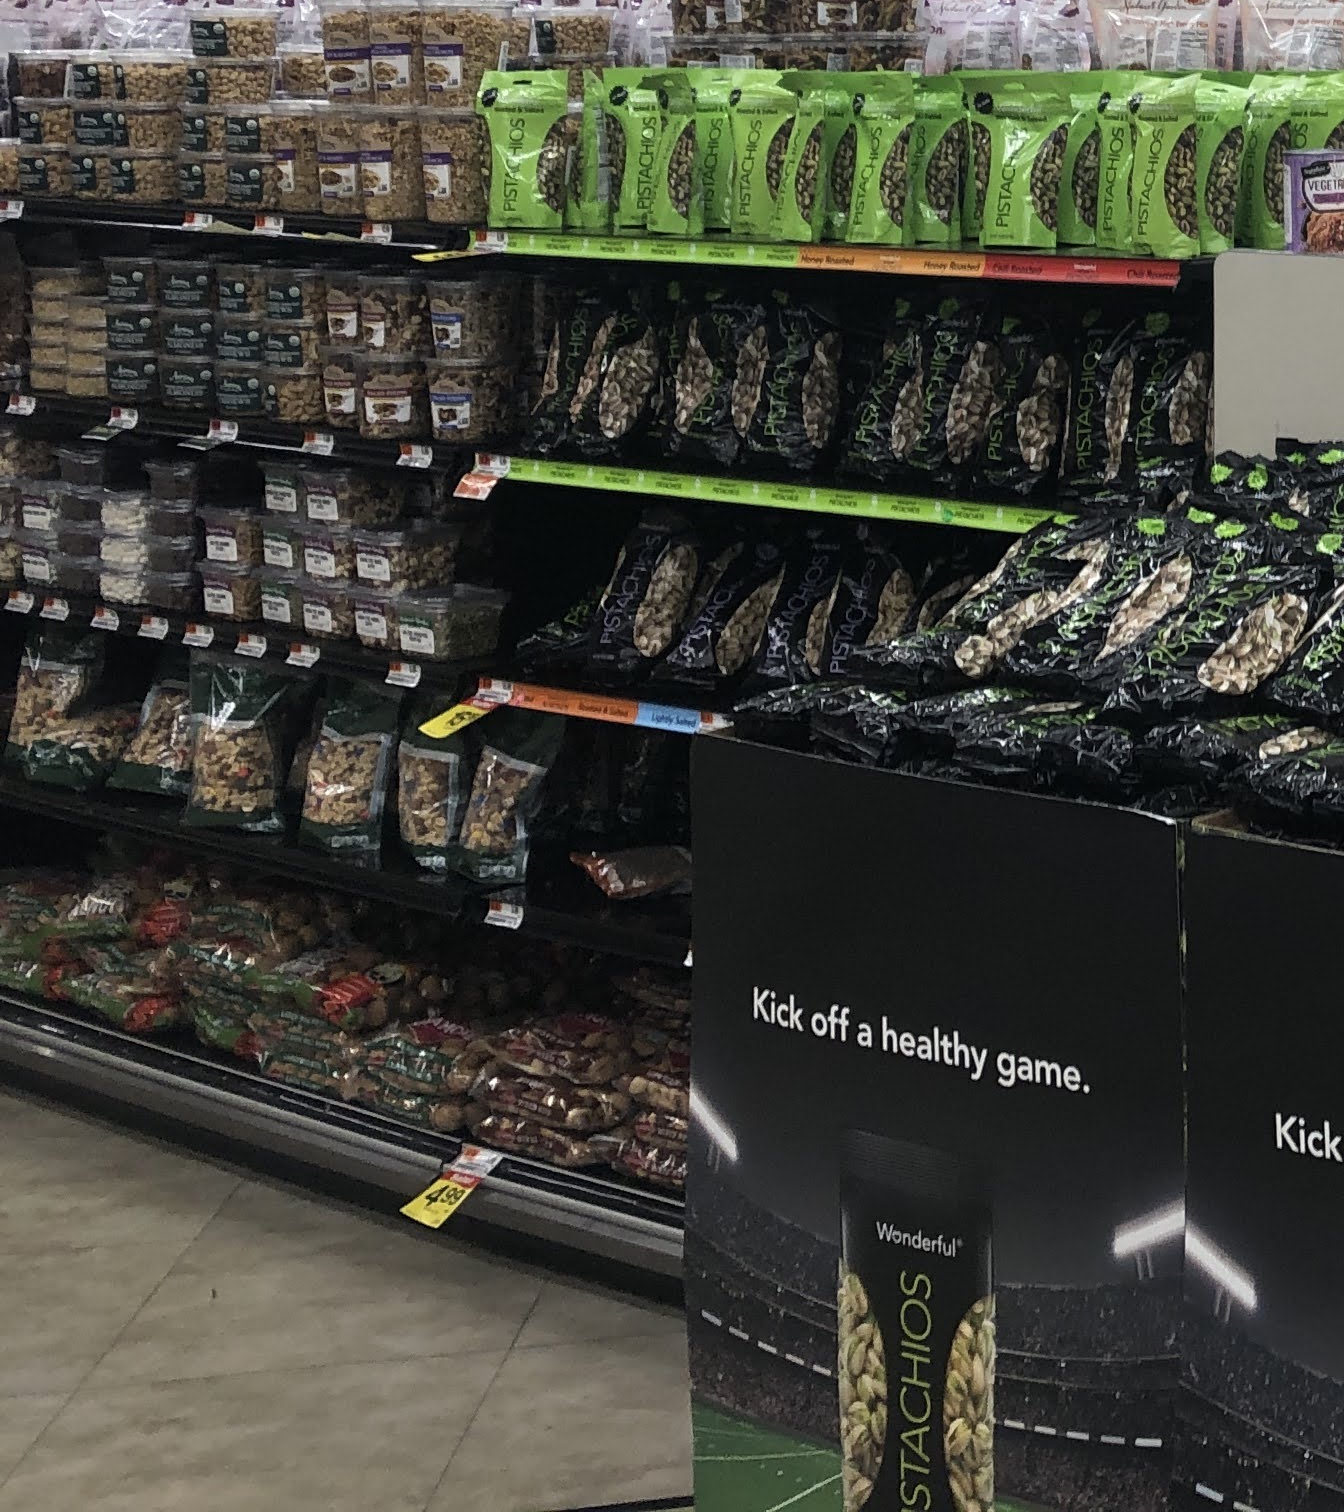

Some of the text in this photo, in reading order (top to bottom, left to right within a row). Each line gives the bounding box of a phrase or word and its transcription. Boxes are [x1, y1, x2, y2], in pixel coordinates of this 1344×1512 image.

[504, 116, 526, 213] PISTACHIOS
[739, 119, 762, 217] PISTACHIOS
[852, 126, 882, 226] PISTACHIOS
[1103, 126, 1124, 232] PISTACHIOS
[1137, 128, 1164, 236] PISTACHIOS
[752, 984, 1091, 1094] Kick off a healthy game.
[1274, 1111, 1343, 1163] Kick
[876, 1219, 958, 1259] Wonderful
[898, 1269, 933, 1512] STACHIOS
